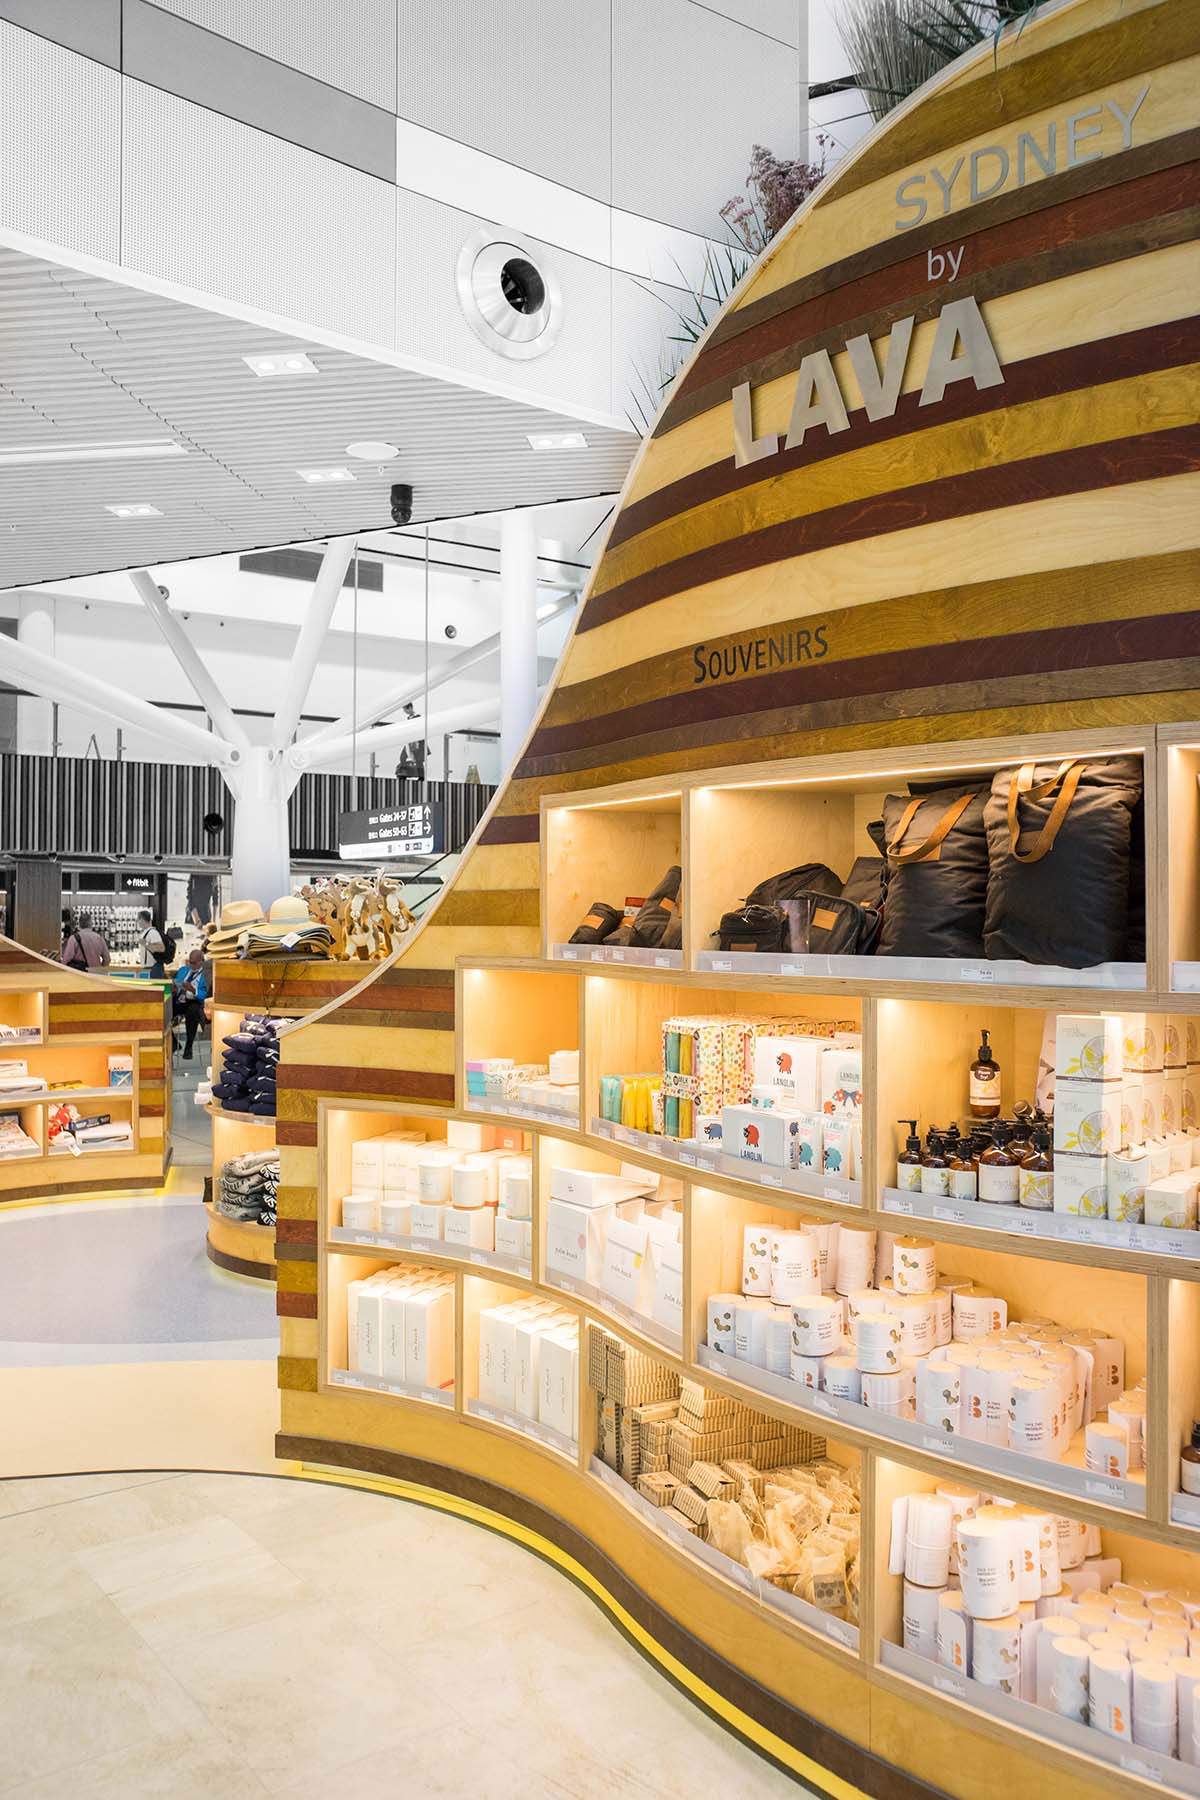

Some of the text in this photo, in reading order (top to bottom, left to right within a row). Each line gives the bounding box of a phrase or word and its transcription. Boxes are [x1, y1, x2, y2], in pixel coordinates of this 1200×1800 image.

[895, 85, 1152, 231] SYDNEY
[927, 246, 966, 282] by
[732, 296, 1005, 469] LAVA
[693, 625, 829, 685] SOUVENIRS
[380, 814, 392, 823] Gates
[379, 829, 392, 838] Gates
[132, 878, 149, 887] fitbit
[773, 1077, 796, 1088] LANOLIN
[740, 1149, 763, 1162] LANOLIN
